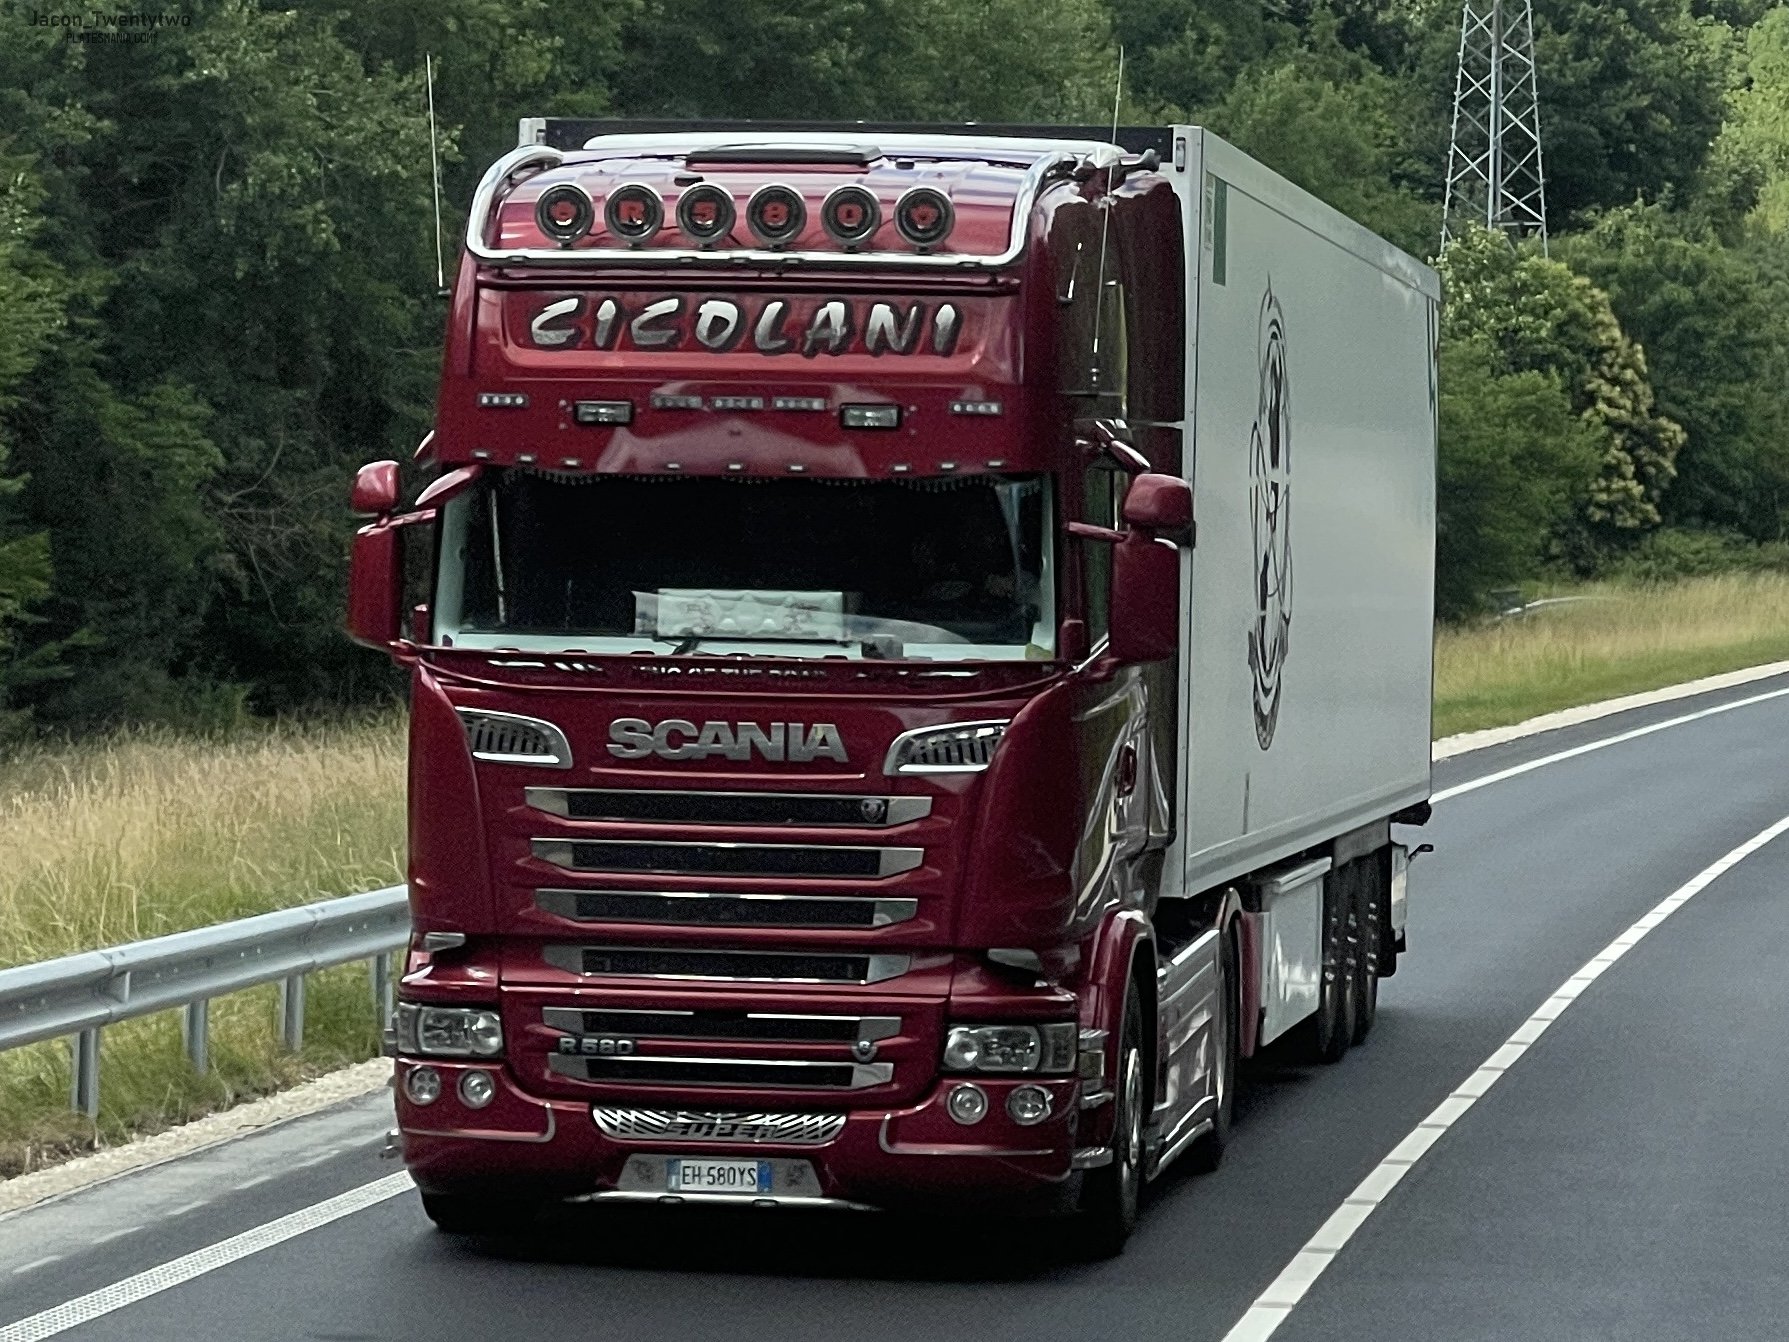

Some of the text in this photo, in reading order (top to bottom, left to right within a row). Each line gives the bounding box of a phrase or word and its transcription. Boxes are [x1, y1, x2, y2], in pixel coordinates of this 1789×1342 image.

[530, 298, 962, 358] CICOLANI
[606, 717, 849, 763] SCANIA
[664, 1122, 780, 1139] SUPER
